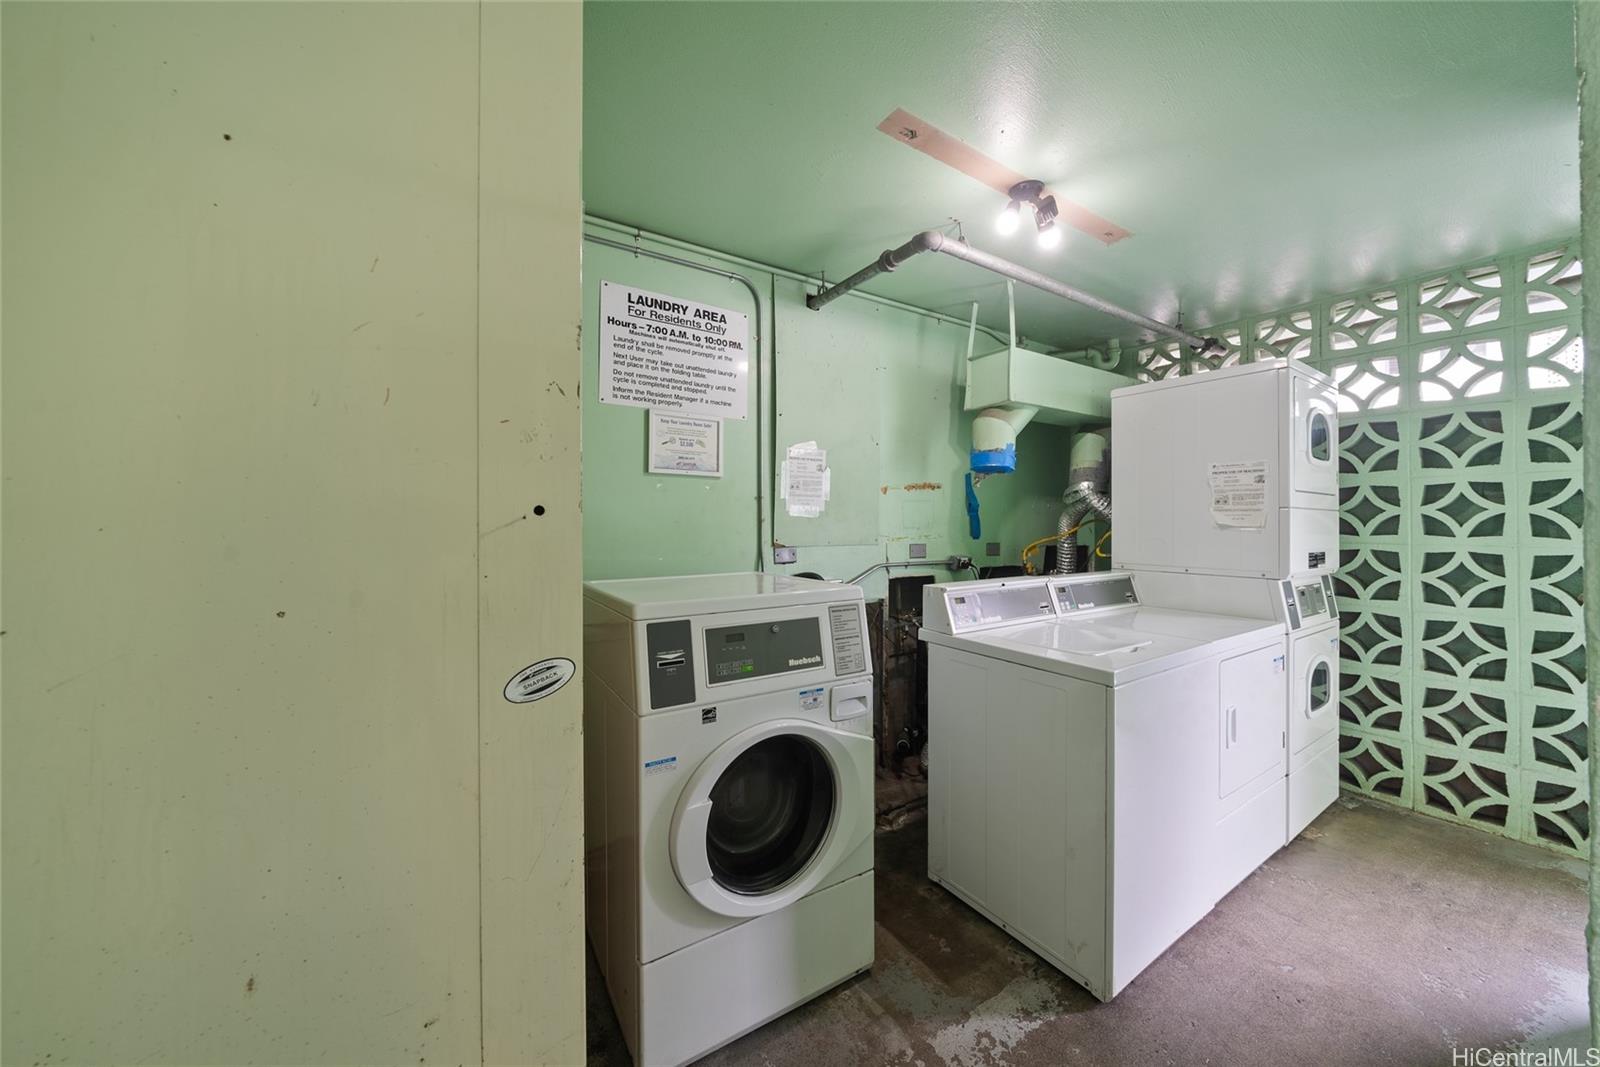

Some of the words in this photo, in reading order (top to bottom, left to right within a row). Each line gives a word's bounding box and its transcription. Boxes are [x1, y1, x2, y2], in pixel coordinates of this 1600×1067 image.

[628, 293, 688, 315] LAUNDRY
[694, 308, 727, 324] AREA
[628, 305, 646, 316] For
[650, 310, 701, 328] Residents
[705, 322, 727, 335] Only
[607, 316, 637, 329] Hours
[646, 324, 668, 335] 7:00
[669, 329, 689, 340] A.M.
[692, 334, 701, 342] to
[704, 336, 728, 347] 10:00
[629, 329, 656, 339] Machines
[669, 338, 704, 349] automatically
[613, 334, 639, 345] Laundry
[666, 346, 690, 354] removed
[692, 350, 716, 360] promptly
[645, 358, 658, 366] may
[685, 365, 716, 374] unattended
[718, 370, 736, 379] laundry
[672, 368, 690, 378] folding
[638, 380, 670, 389] completed
[660, 377, 692, 386] unattended
[694, 381, 714, 391] laundry
[613, 385, 633, 393] Inform
[646, 390, 672, 398] Resident
[674, 394, 698, 403] Manager
[632, 396, 657, 405] working
[789, 655, 821, 666] Huebsch
[523, 672, 558, 690] SNAPBACK
